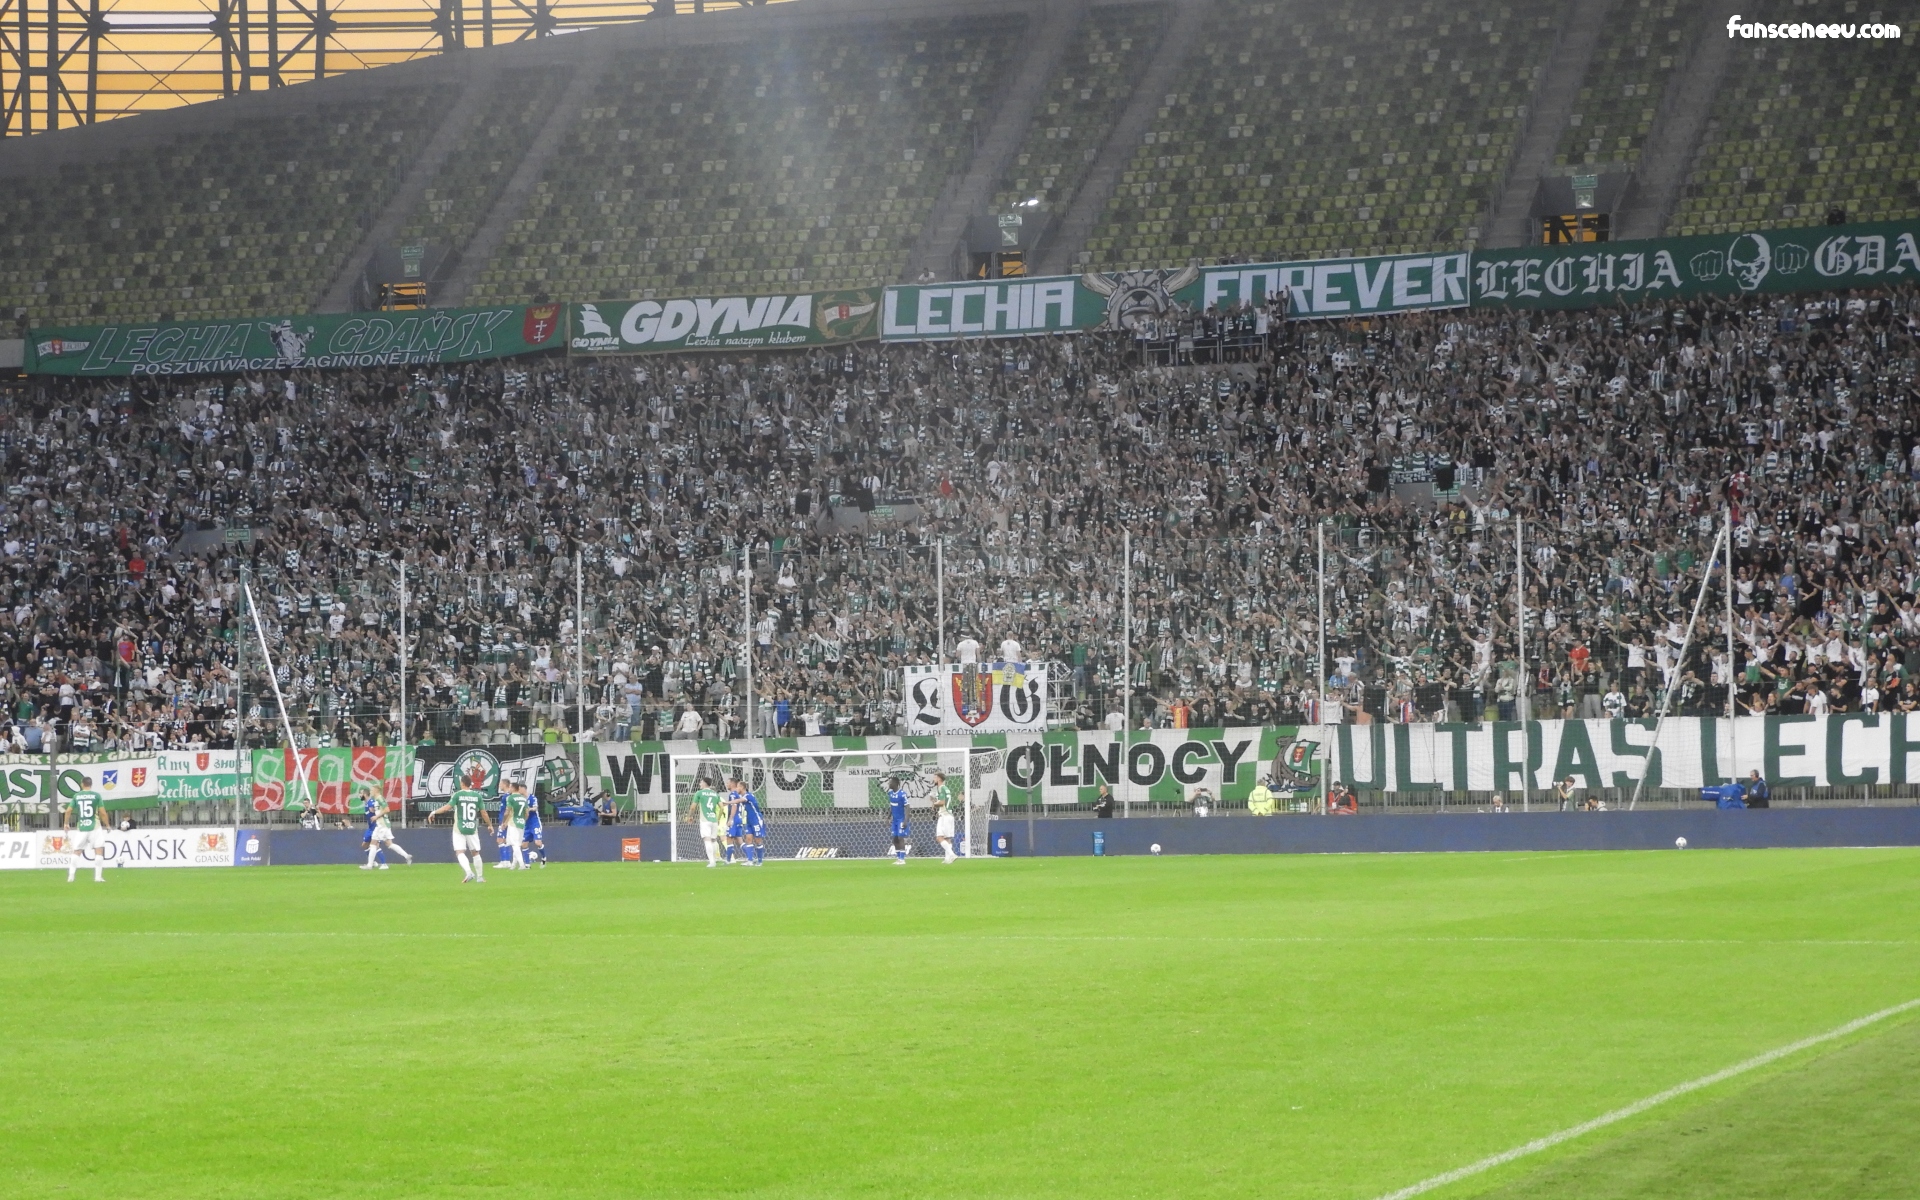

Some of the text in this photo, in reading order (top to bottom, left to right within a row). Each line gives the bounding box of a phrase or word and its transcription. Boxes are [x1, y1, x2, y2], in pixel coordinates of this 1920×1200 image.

[1475, 249, 1684, 300] LECHIA
[882, 253, 1467, 336] LECHIA FOREVER
[620, 294, 813, 345] GDYNIA
[81, 310, 514, 371] LECHIA GDAŃSK
[571, 336, 620, 349] GDYNIA
[684, 331, 807, 348] Lechia naszym klubem
[130, 357, 287, 376] POSZUKIWACZE
[1337, 718, 1663, 792] ULTRAS
[77, 800, 93, 818] 15
[460, 803, 477, 821] 16
[518, 801, 525, 816] 7
[706, 797, 714, 810] 4
[40, 854, 72, 865] GDAŃS
[195, 853, 230, 863] GDAŃSK
[794, 846, 839, 859] LVBET.PL
